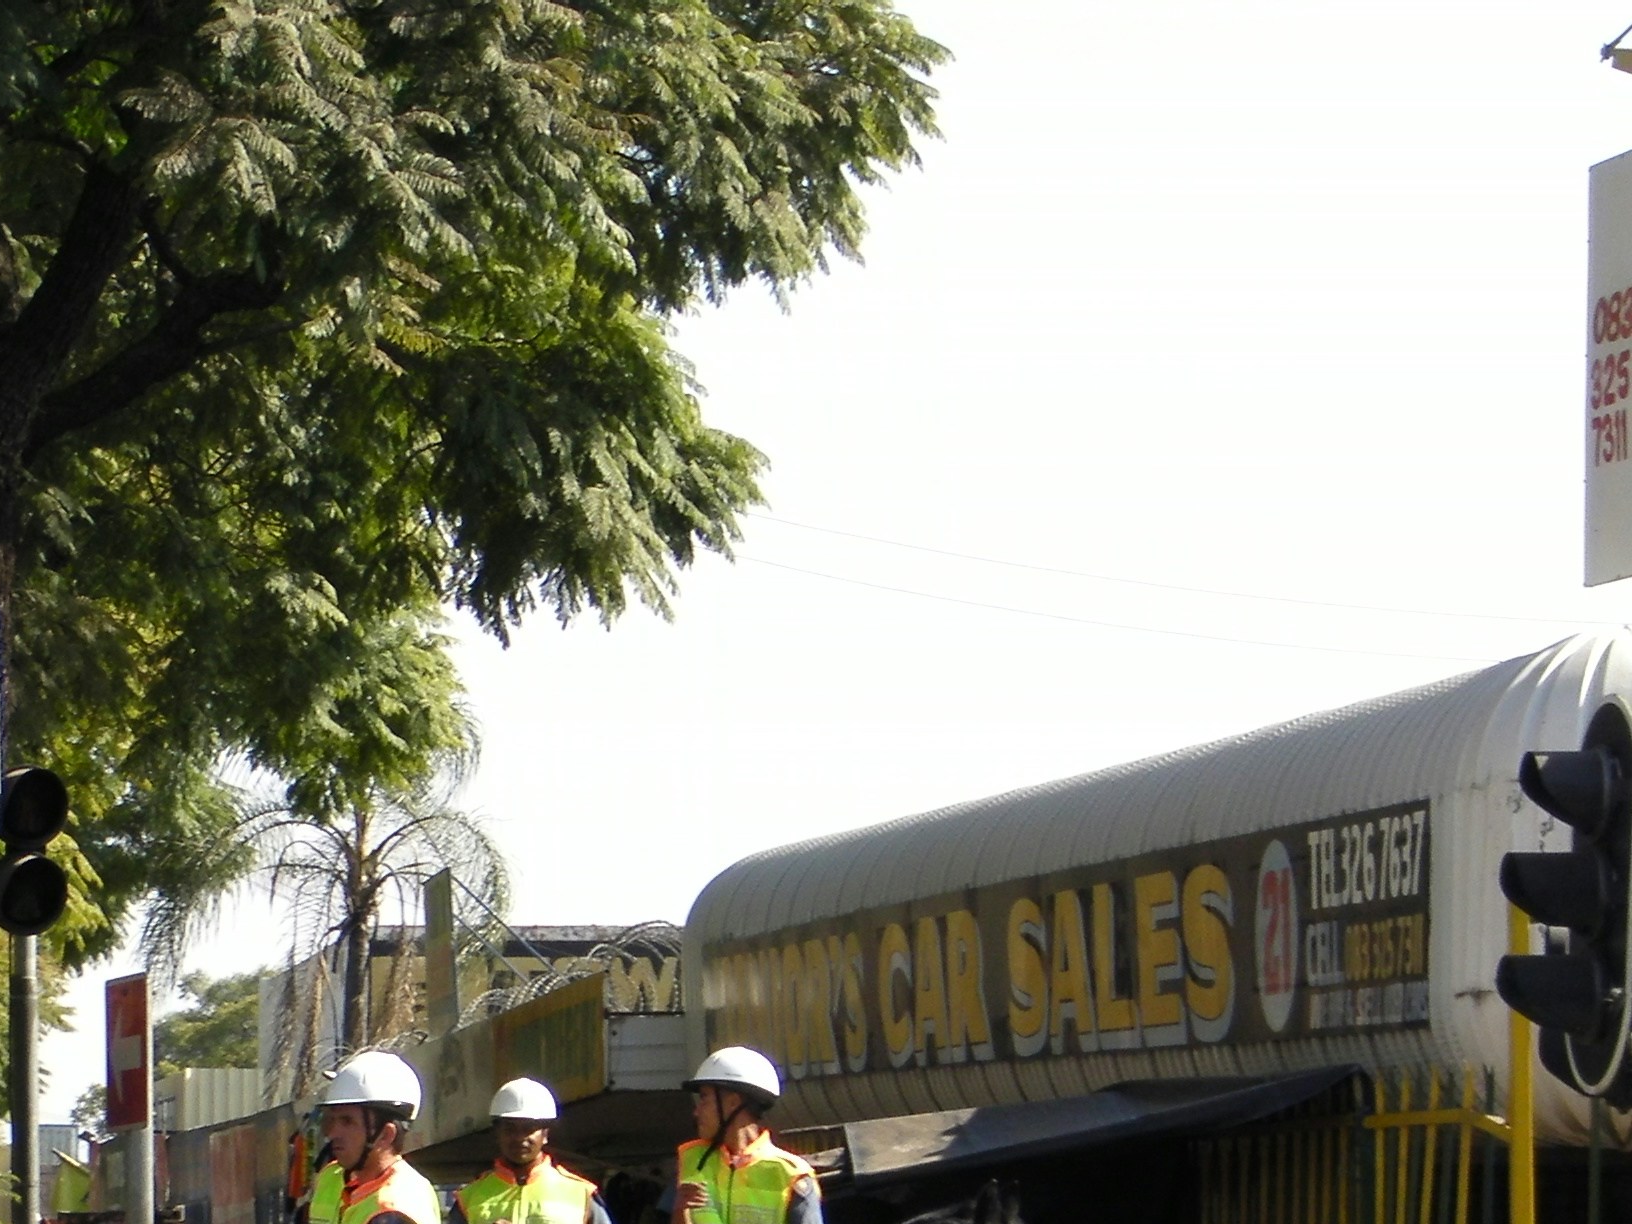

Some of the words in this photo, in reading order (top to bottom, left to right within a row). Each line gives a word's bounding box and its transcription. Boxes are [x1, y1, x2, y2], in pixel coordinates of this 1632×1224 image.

[1593, 286, 1632, 345] 083
[1591, 350, 1630, 410] 325
[1592, 408, 1628, 467] 7311
[1261, 866, 1291, 996] 21
[878, 908, 996, 1068] CAR
[1006, 863, 1236, 1057] SALES
